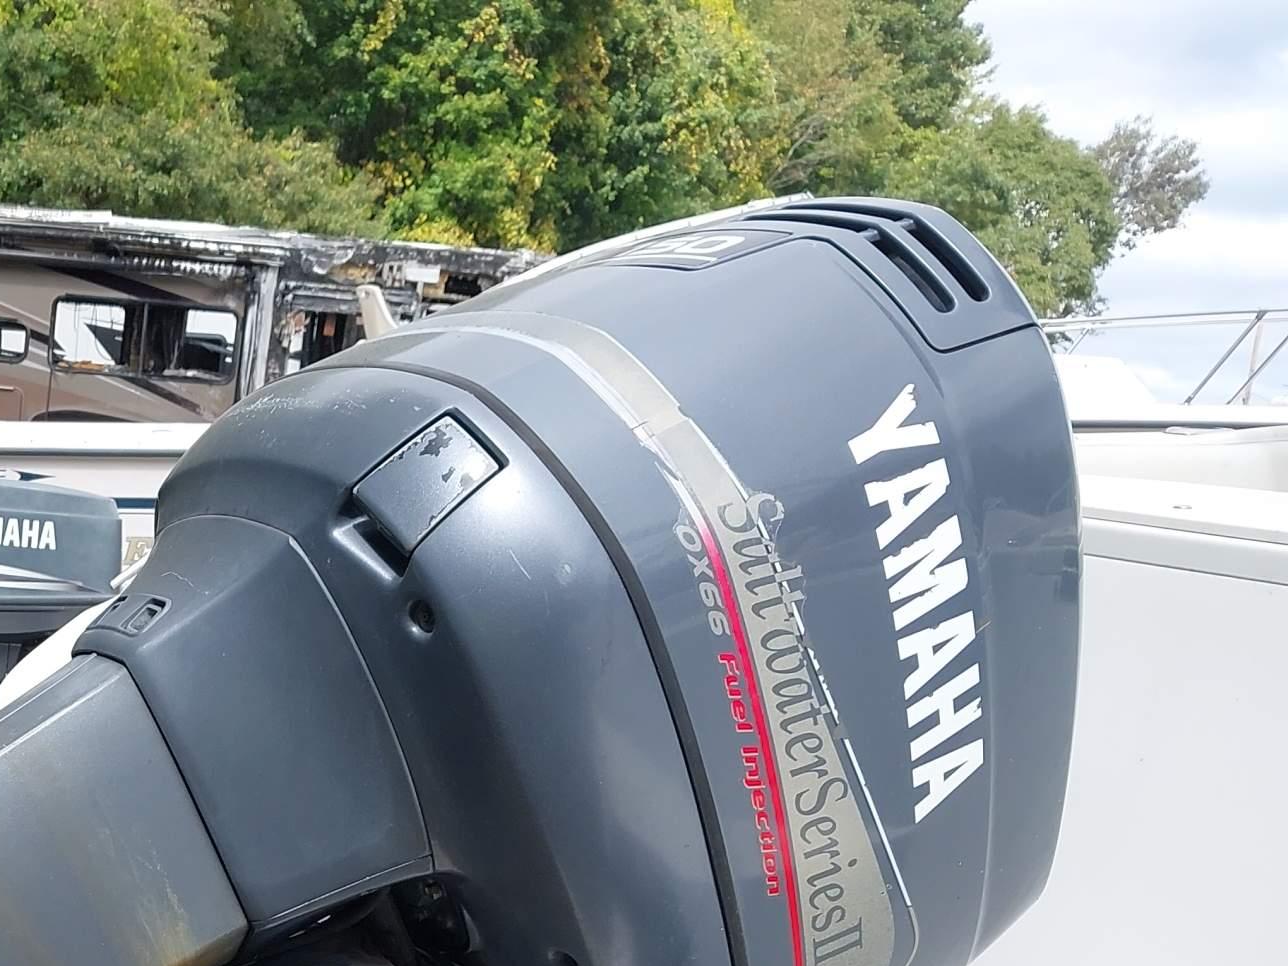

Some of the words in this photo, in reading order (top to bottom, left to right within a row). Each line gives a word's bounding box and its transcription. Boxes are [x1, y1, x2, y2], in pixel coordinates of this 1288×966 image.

[675, 524, 731, 637] OX66
[847, 383, 985, 825] YAMAHA
[718, 652, 754, 733] Fuel
[741, 746, 779, 897] Injection
